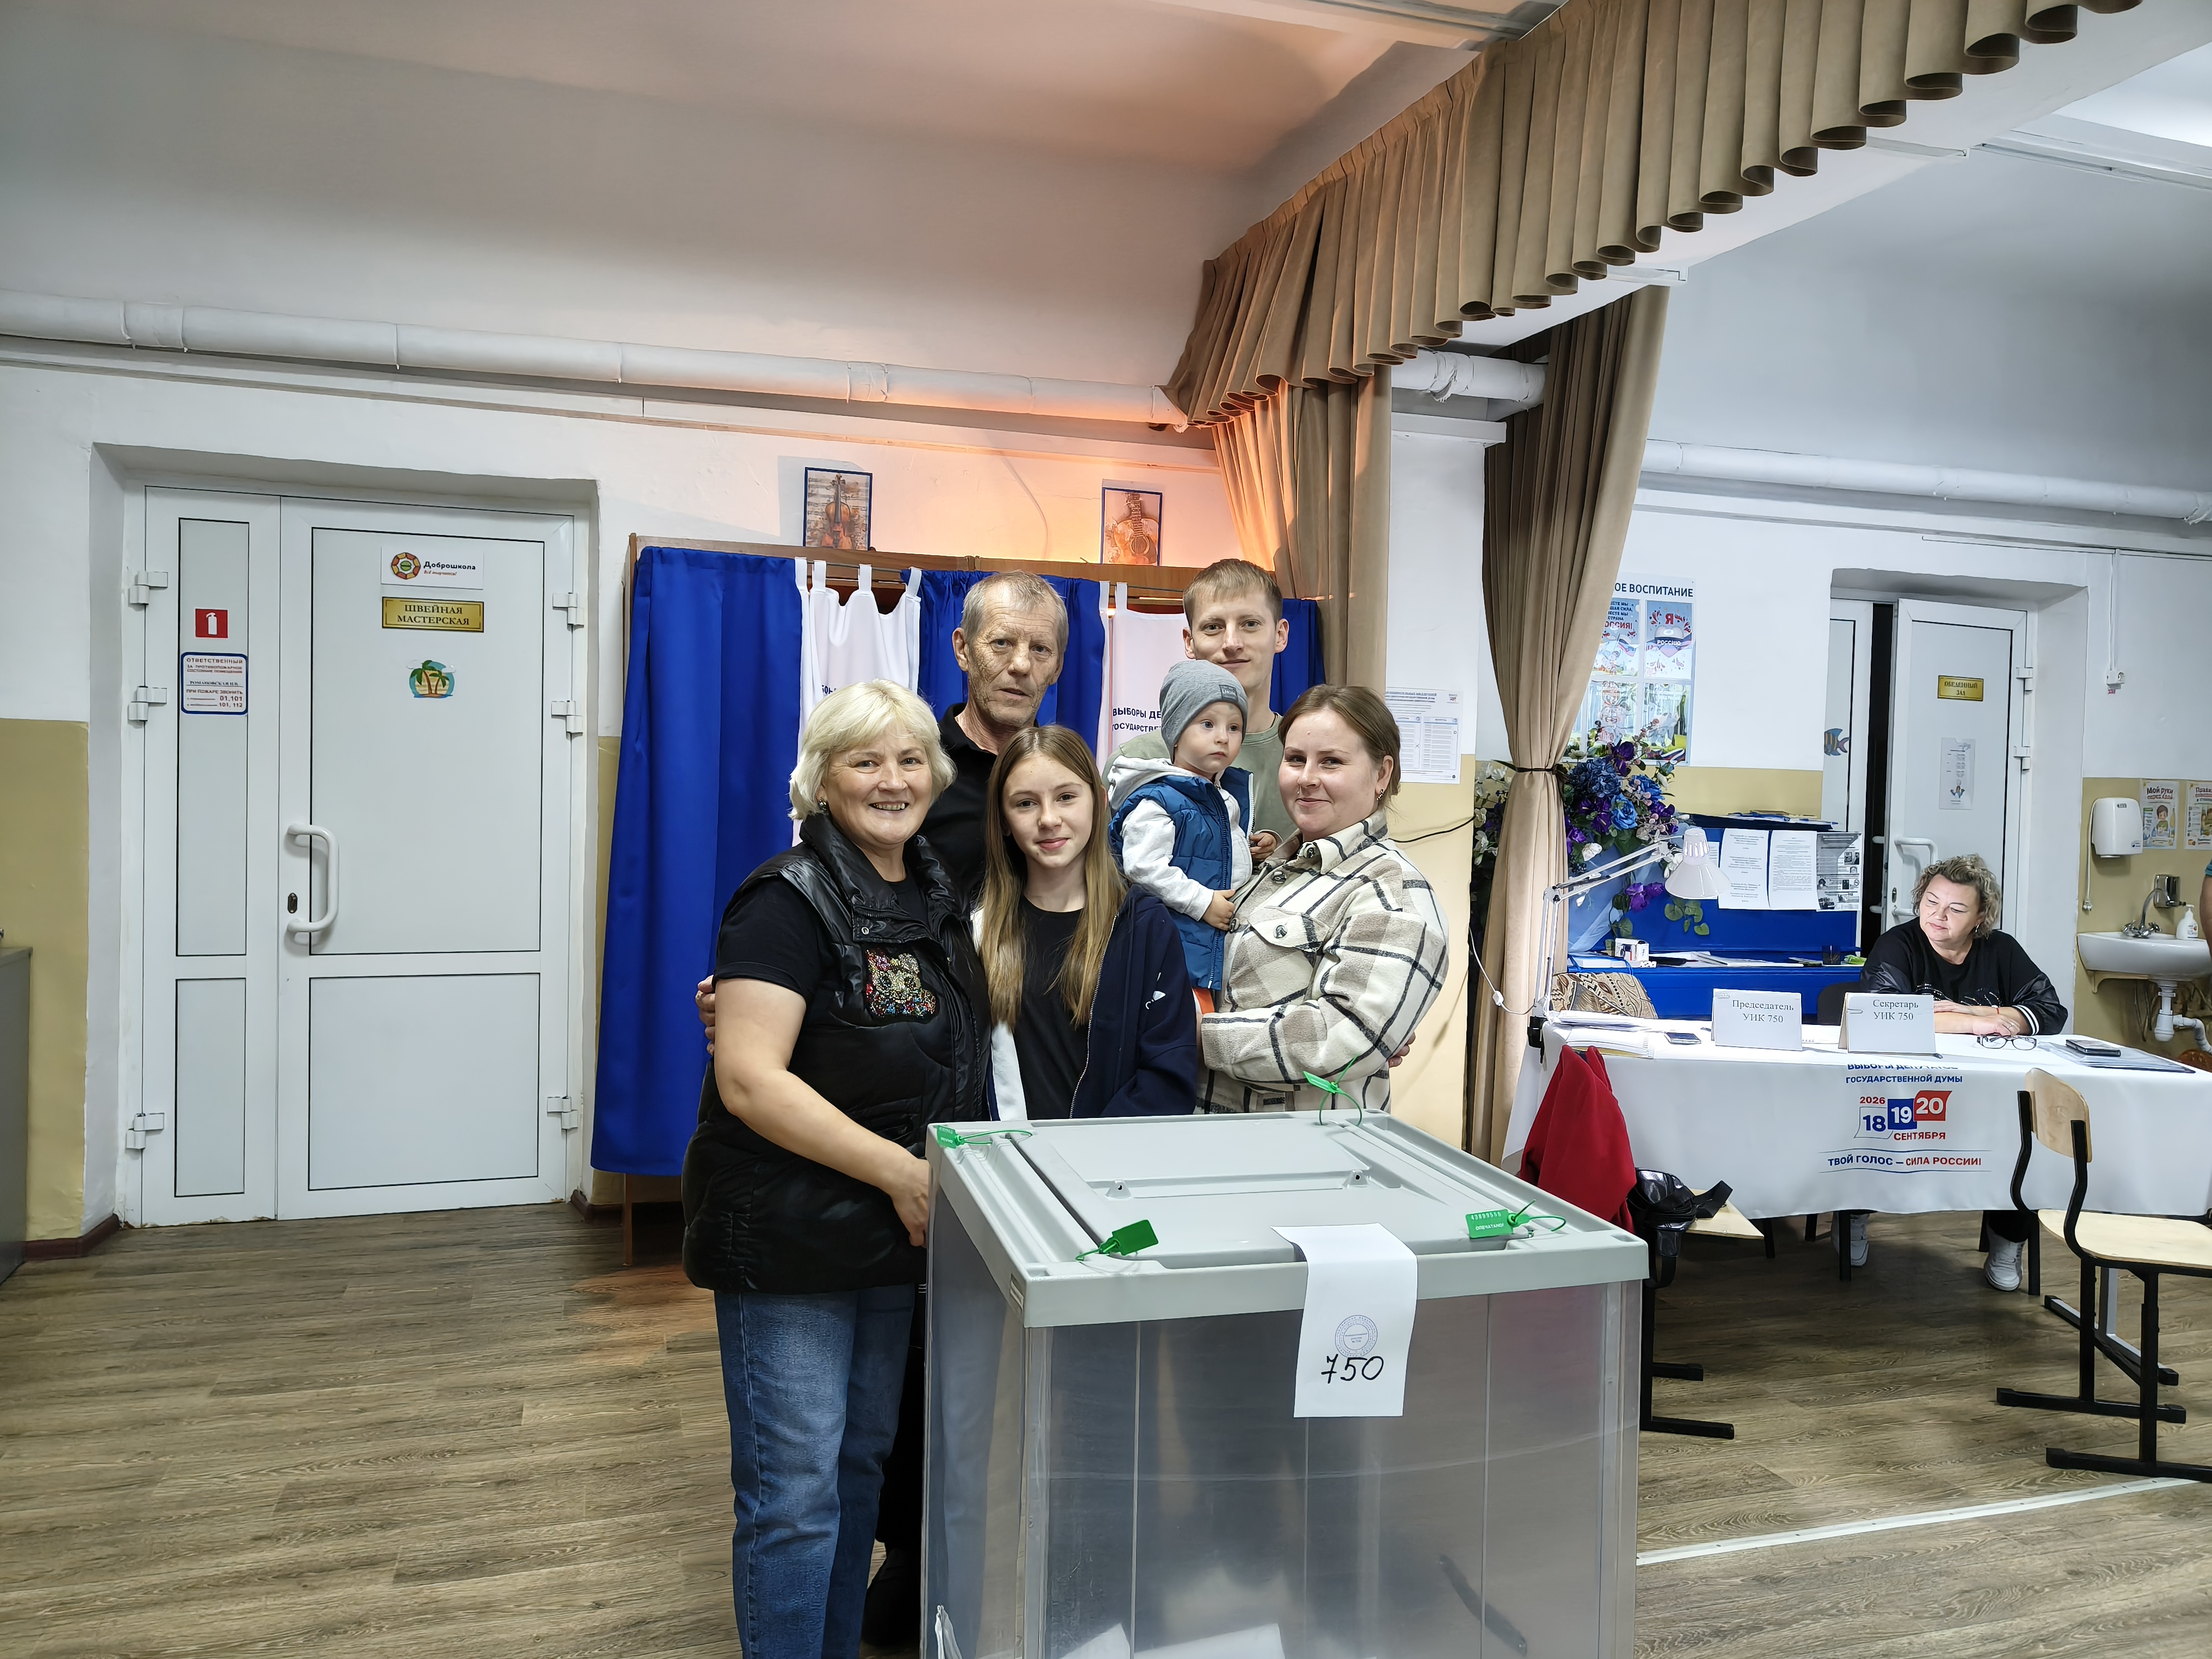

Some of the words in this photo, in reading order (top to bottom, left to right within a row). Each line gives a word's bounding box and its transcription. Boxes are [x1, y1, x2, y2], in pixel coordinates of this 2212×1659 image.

[423, 561, 476, 570] Доброшкола
[1629, 584, 1694, 597] ВОСПИТАНИЕ
[405, 604, 462, 614] ШВЕЙНАЯ
[397, 615, 469, 625] МАСТЕРСКАЯ
[1665, 613, 1674, 624] Я
[1112, 707, 1146, 718] ВЫБОРЫ
[1732, 1000, 1793, 1010] Председатель
[1873, 999, 1918, 1009] Секретарь
[1743, 1013, 1765, 1022] УИК
[1873, 1011, 1895, 1020] УИК
[1846, 1074, 1932, 1083] ГОСУДАРСТВЕННОЙ
[1859, 1096, 1885, 1104] 2026
[1863, 1115, 1886, 1131] 18
[1891, 1107, 1912, 1123] 19
[1916, 1097, 1944, 1114] 20
[1893, 1132, 1946, 1141] СЕНТЯБРЯ
[1828, 1154, 1853, 1166] ТВОЙ
[1857, 1155, 1893, 1165] ГОЛОС
[1906, 1157, 1930, 1165] СИЛА
[1933, 1157, 1981, 1166] РОССИИ!
[1321, 1354, 1384, 1384] 750
